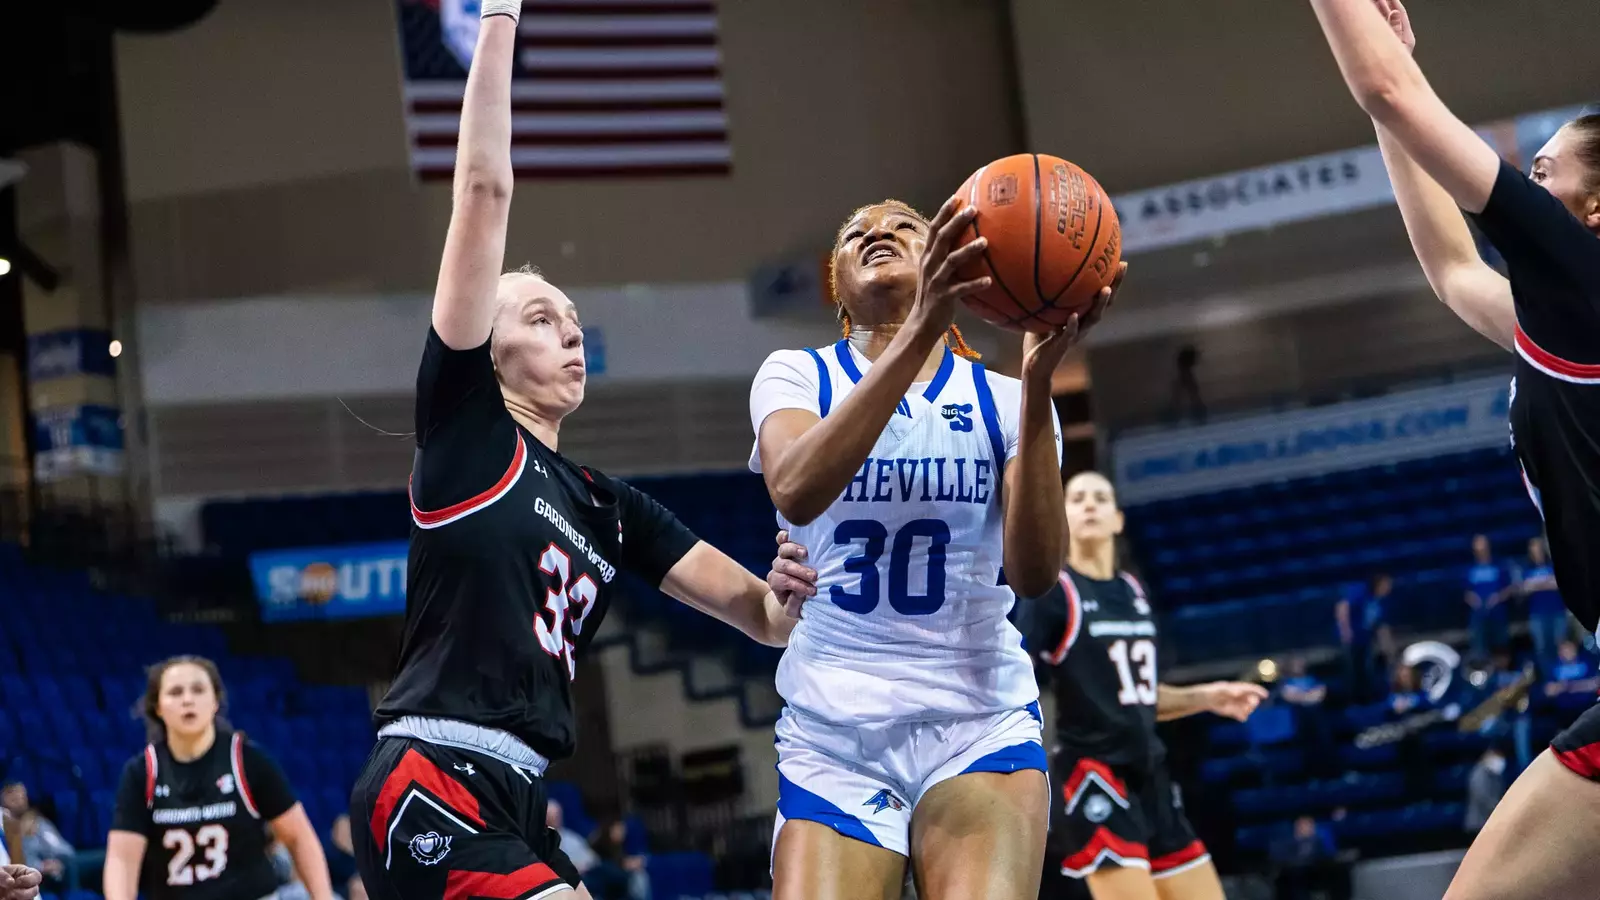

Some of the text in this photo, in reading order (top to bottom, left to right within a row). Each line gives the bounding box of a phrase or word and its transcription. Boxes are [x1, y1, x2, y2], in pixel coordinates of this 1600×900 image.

[1140, 158, 1362, 220] ASSOCIATES
[941, 407, 959, 416] BIG
[843, 457, 991, 505] HEVILLE
[829, 519, 951, 616] 30
[1108, 639, 1158, 705] 13
[162, 824, 229, 886] 23
